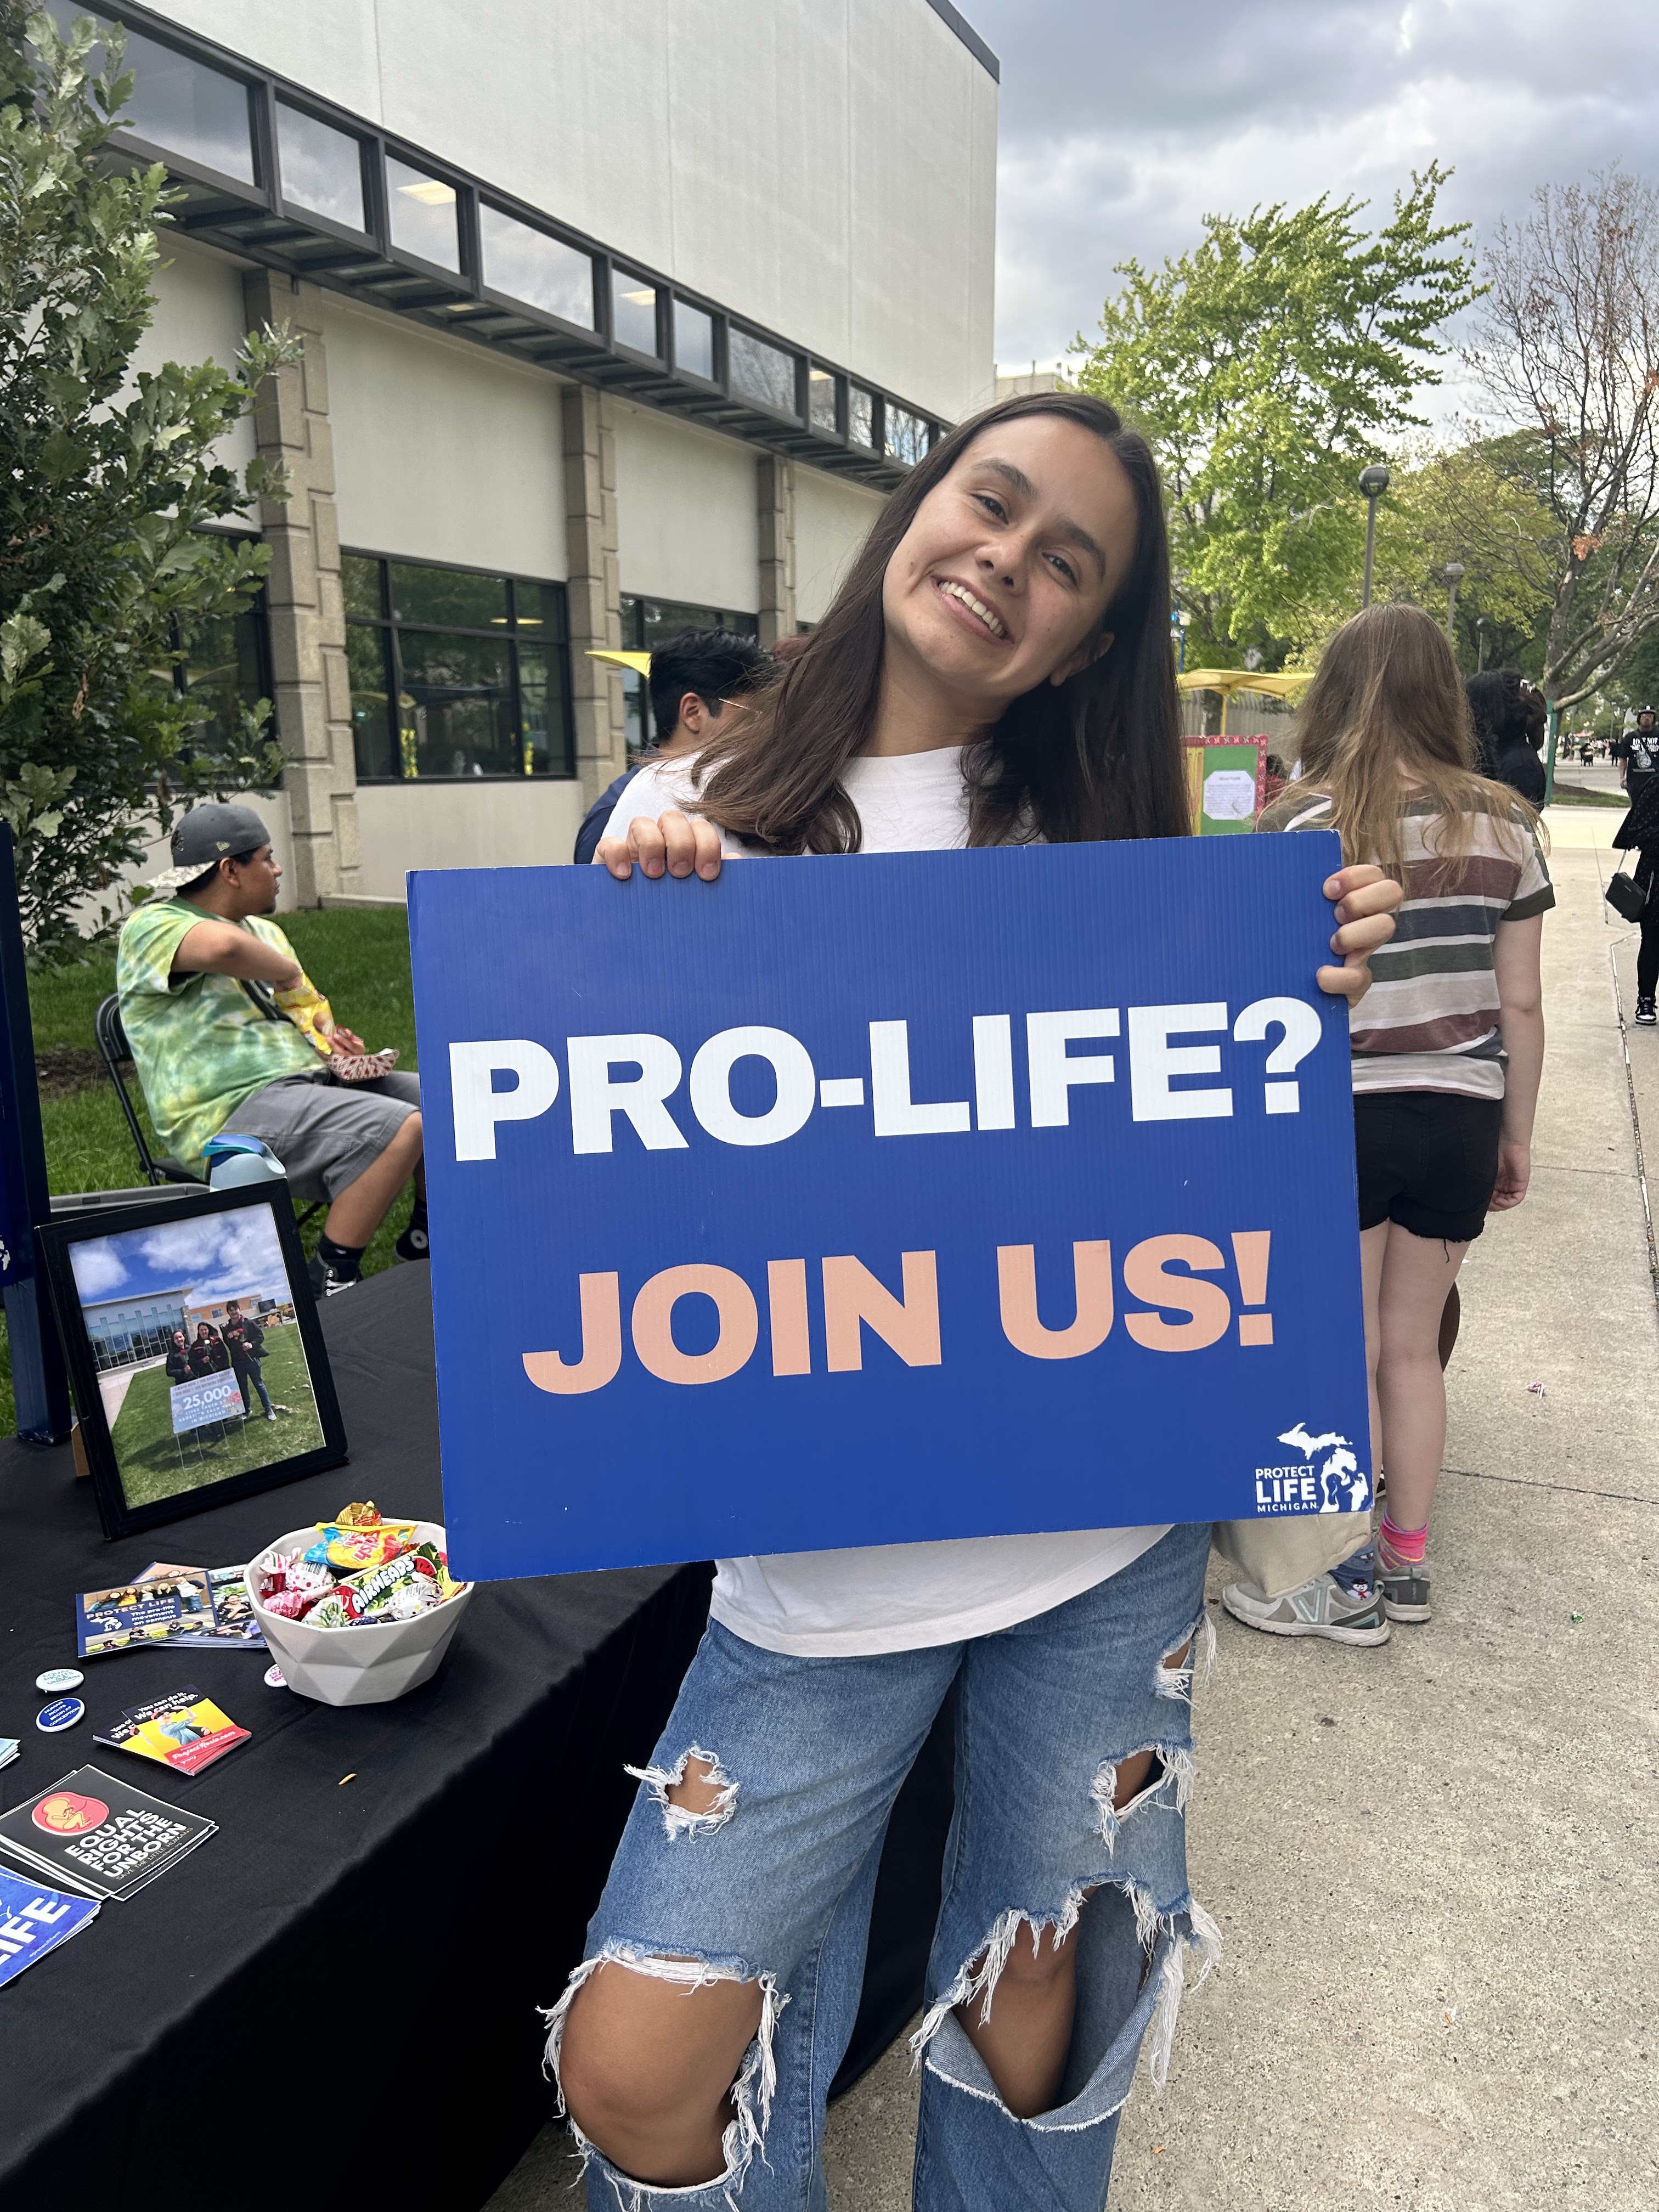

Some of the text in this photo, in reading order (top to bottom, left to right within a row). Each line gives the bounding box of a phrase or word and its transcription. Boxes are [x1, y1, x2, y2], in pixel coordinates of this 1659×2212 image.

[449, 997, 1322, 1161] PRO-LIFE?
[522, 1230, 1273, 1395] JOIN US!
[183, 1385, 231, 1410] 25,000
[1255, 1465, 1315, 1480] PROTECT
[1256, 1477, 1317, 1503] LIFE
[1257, 1502, 1317, 1513] MICHIGAN
[352, 1555, 416, 1613] AIRHEADS
[86, 1597, 176, 1620] PROTECT LIFE
[131, 1610, 174, 1622] movement
[145, 1614, 177, 1624] campus
[147, 1605, 176, 1615] pro-life
[44, 1701, 64, 1714] HUMAN
[49, 1706, 81, 1726] CONCEPTION
[134, 1692, 199, 1720] We can help.
[138, 1704, 154, 1713] You
[154, 1699, 168, 1707] can
[167, 1694, 178, 1702] do
[110, 1724, 126, 1733] You
[111, 1729, 131, 1740] We
[64, 1808, 146, 1857] EQUAL
[77, 1812, 160, 1865] RIGHTS
[89, 1843, 137, 1872] FOR
[131, 1817, 173, 1844] THE
[103, 1822, 188, 1878] UNBORN
[116, 1868, 136, 1881] SAVE
[134, 1859, 147, 1870] THE
[148, 1847, 166, 1861] LITTLE
[165, 1827, 194, 1847] HUMANS
[0, 1897, 71, 1965] IFE
